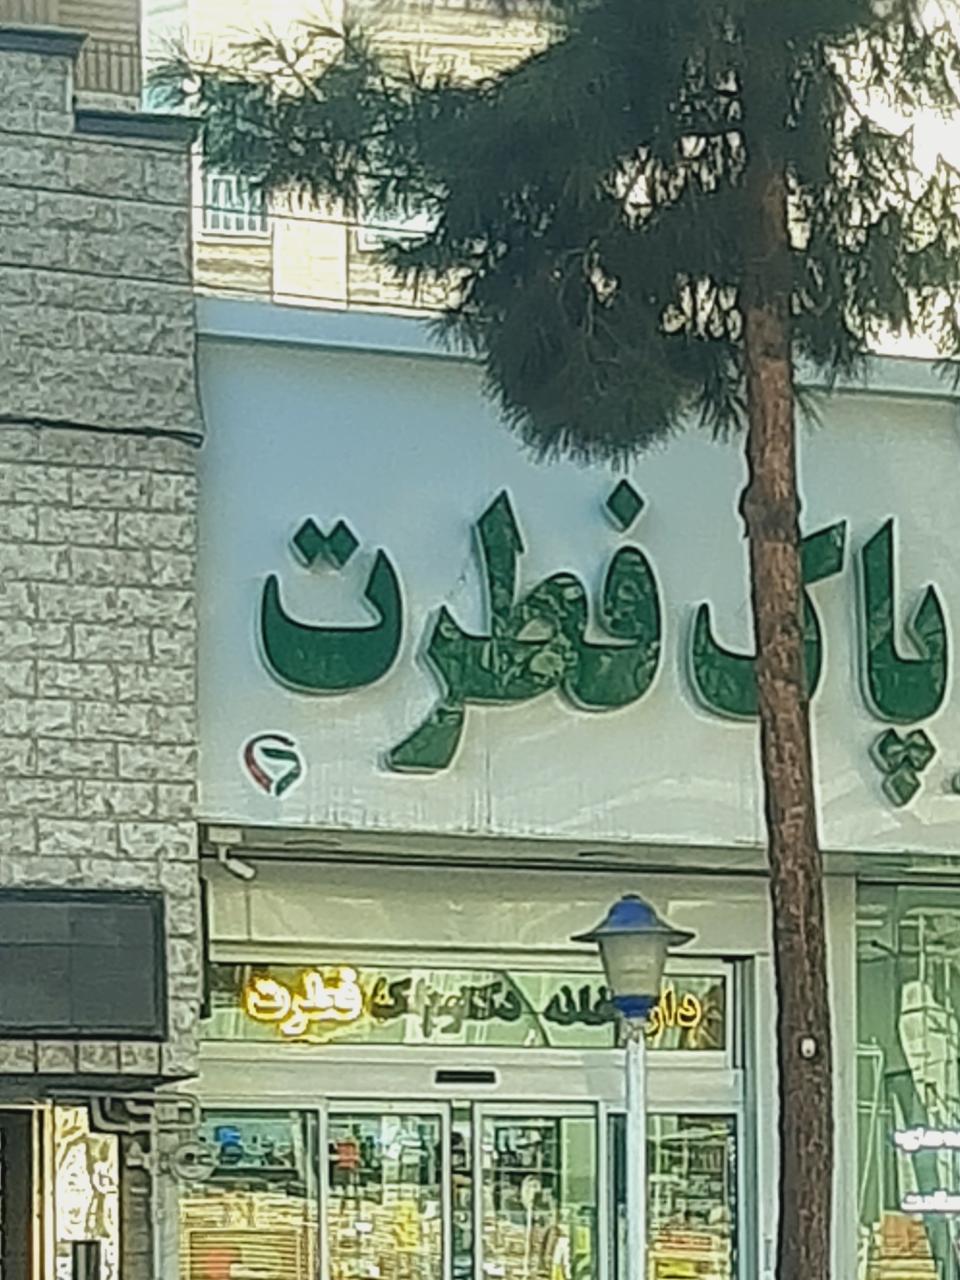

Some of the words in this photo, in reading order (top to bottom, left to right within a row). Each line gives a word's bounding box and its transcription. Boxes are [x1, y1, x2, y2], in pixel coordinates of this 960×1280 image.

[261, 479, 661, 773] فطرت
[689, 518, 949, 806] پاک
[247, 965, 363, 1035] فطرت
